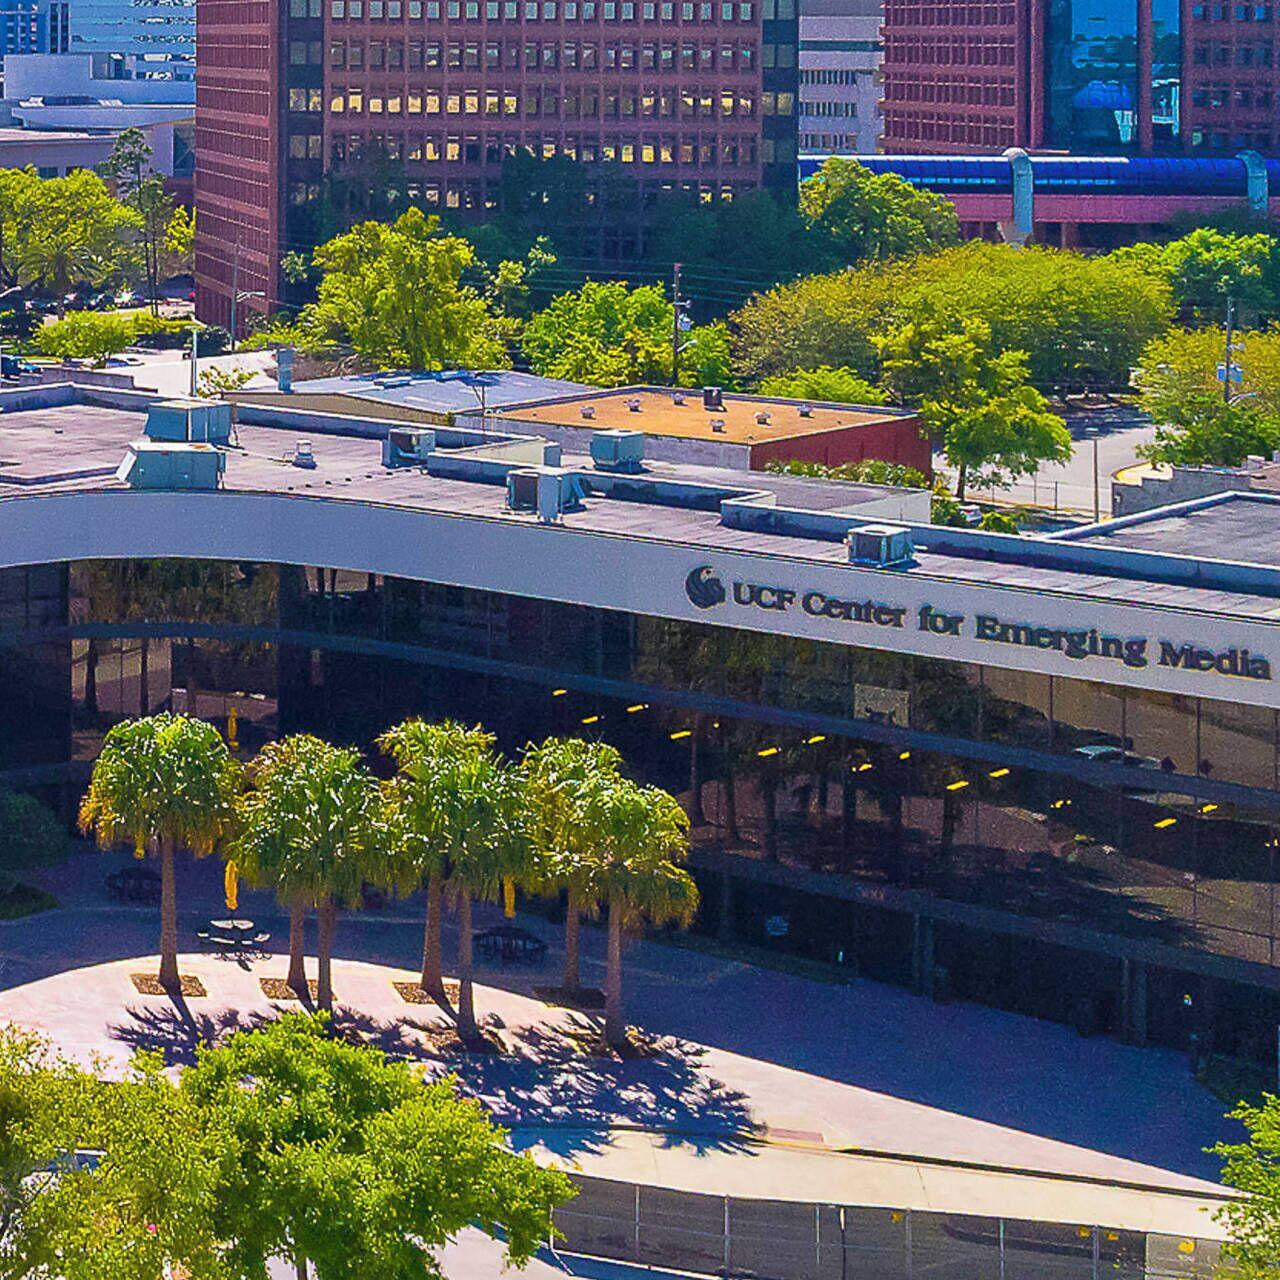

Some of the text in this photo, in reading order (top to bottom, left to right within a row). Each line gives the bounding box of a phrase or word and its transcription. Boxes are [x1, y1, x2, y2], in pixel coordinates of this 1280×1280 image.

[733, 582, 1272, 680] UCF Center for Emerging Media
